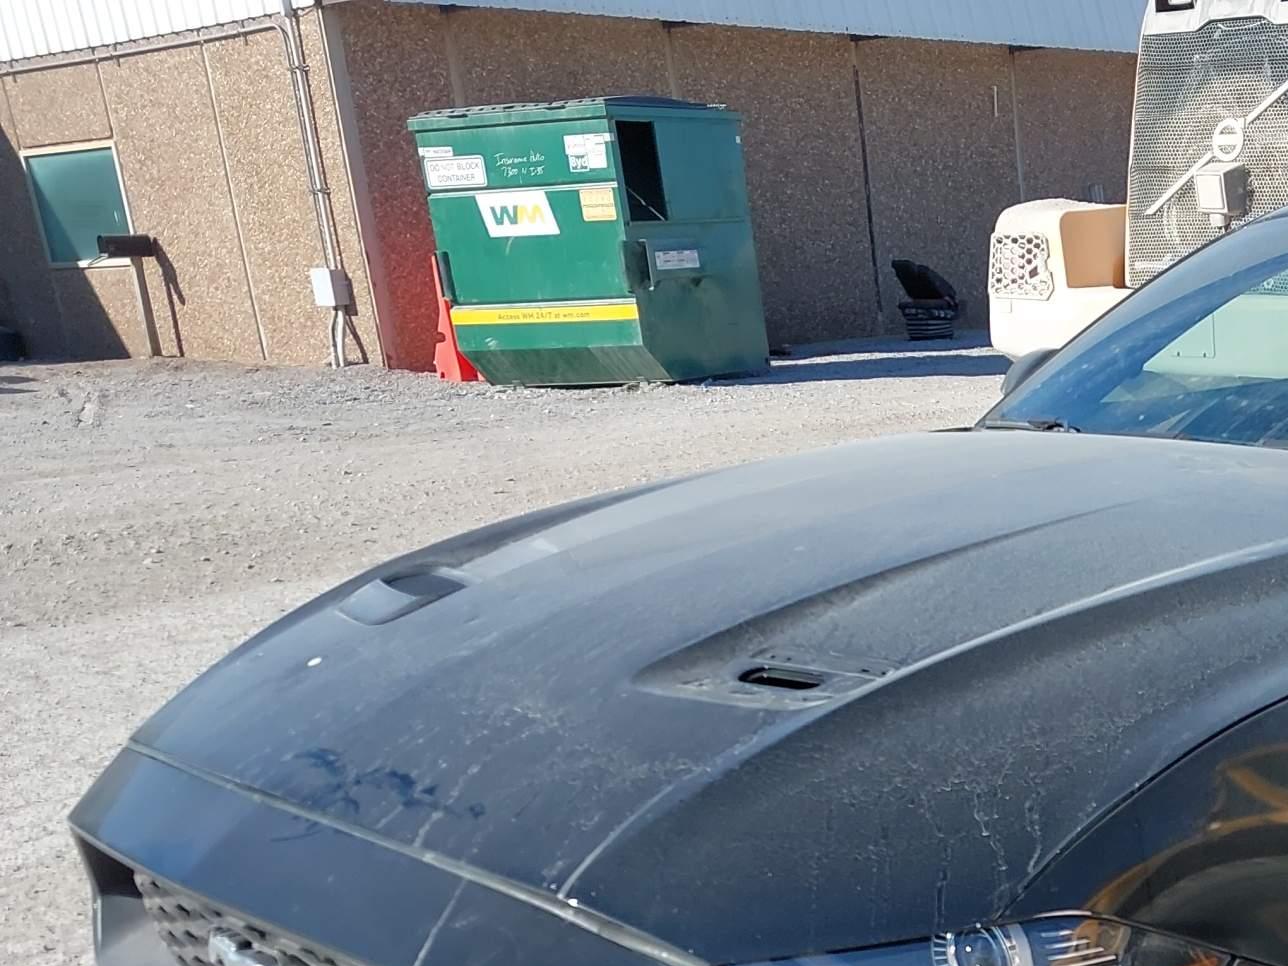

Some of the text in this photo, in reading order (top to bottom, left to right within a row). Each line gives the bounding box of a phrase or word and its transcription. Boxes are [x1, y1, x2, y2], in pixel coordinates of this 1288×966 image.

[430, 163, 440, 172] DO
[457, 161, 480, 170] BLOCK
[438, 173, 475, 183] CONTAINER
[490, 204, 545, 225] WM
